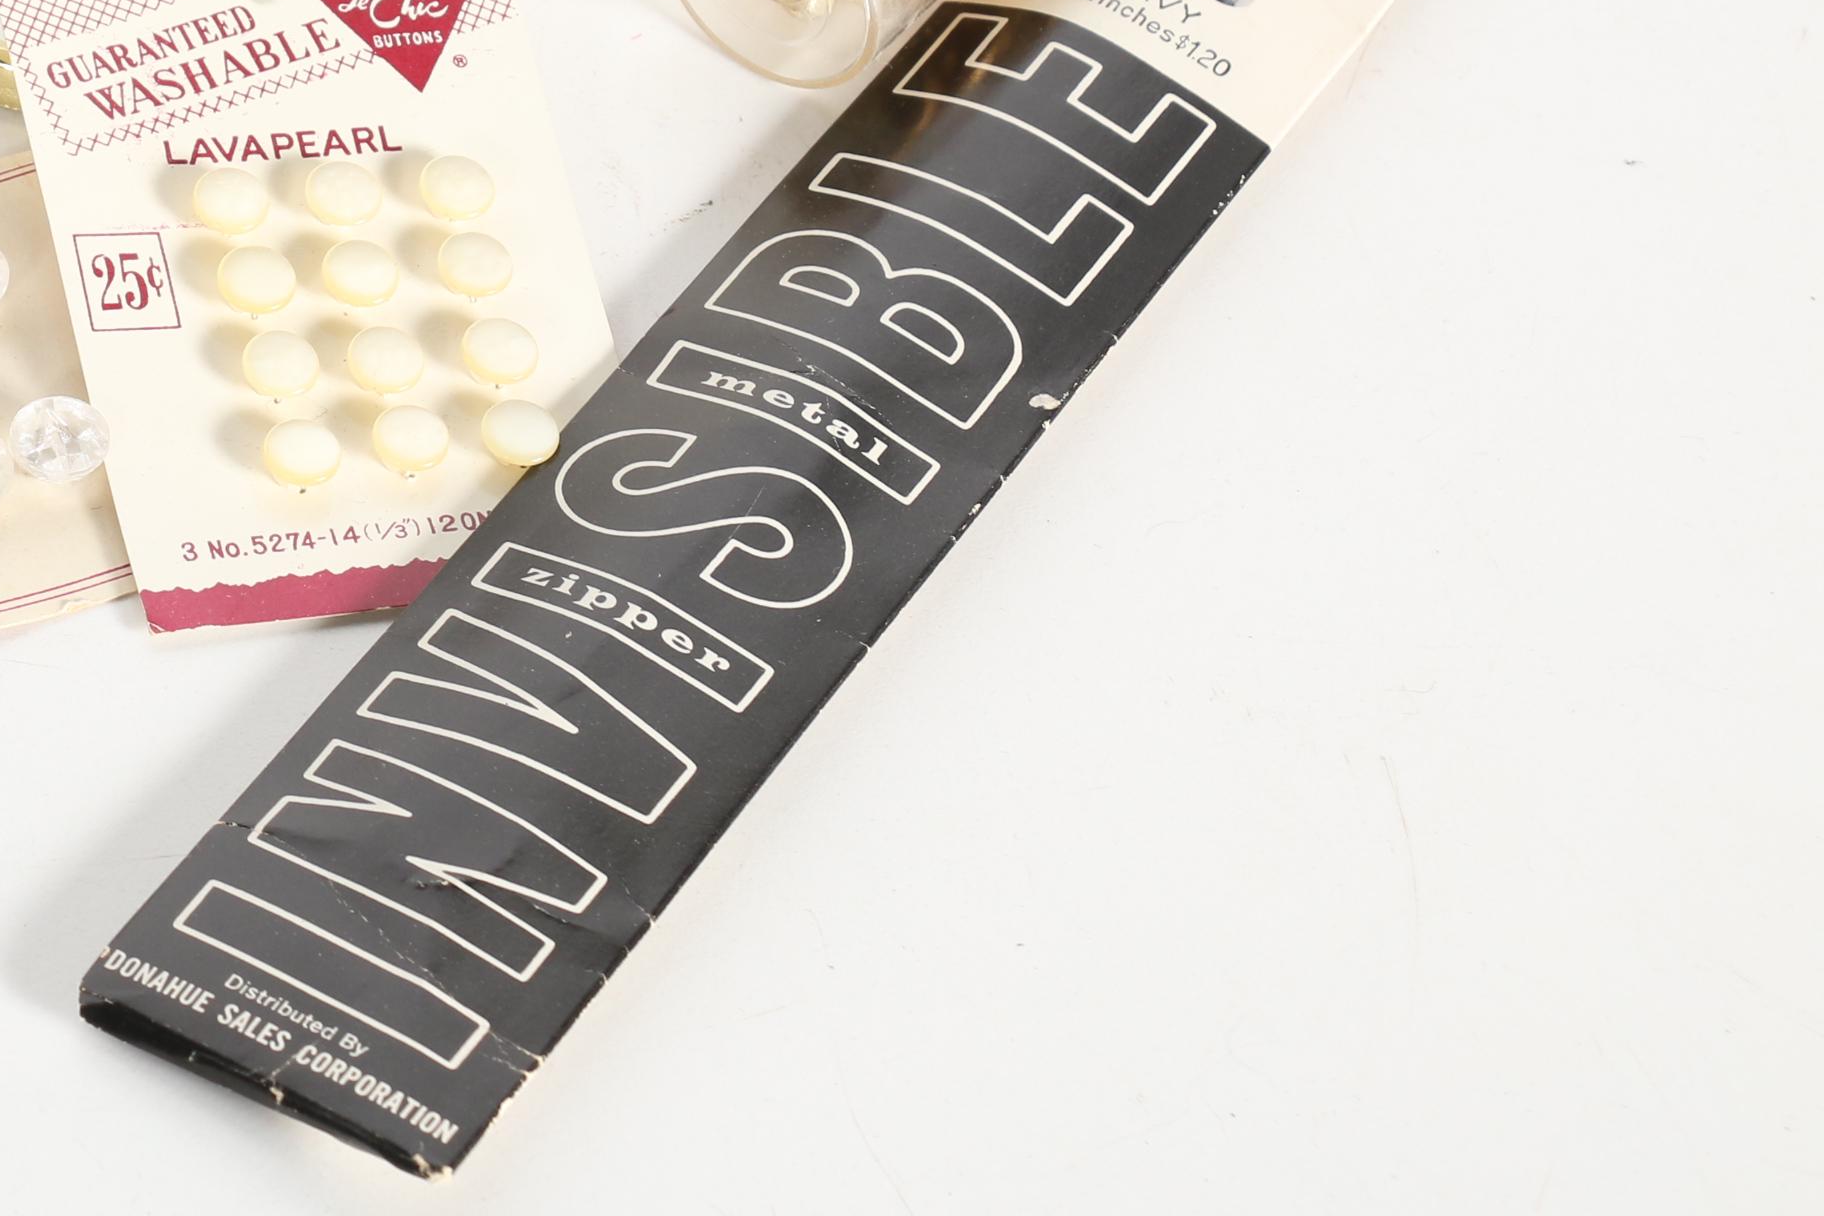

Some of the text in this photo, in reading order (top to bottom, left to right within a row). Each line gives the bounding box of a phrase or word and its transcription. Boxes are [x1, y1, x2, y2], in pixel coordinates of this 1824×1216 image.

[47, 4, 257, 89] GUARANTEED
[83, 17, 341, 121] WASHABLE
[372, 30, 444, 49] BUTTONS
[162, 125, 403, 166] LAVAPEARL
[706, 369, 886, 466] metal
[173, 14, 1216, 1070] INVISIBLE
[181, 542, 198, 561] 3
[520, 566, 734, 675] zipper
[104, 949, 460, 1146] DONAHUE SALES CORPORATION
[224, 973, 370, 1059] Distributed By
